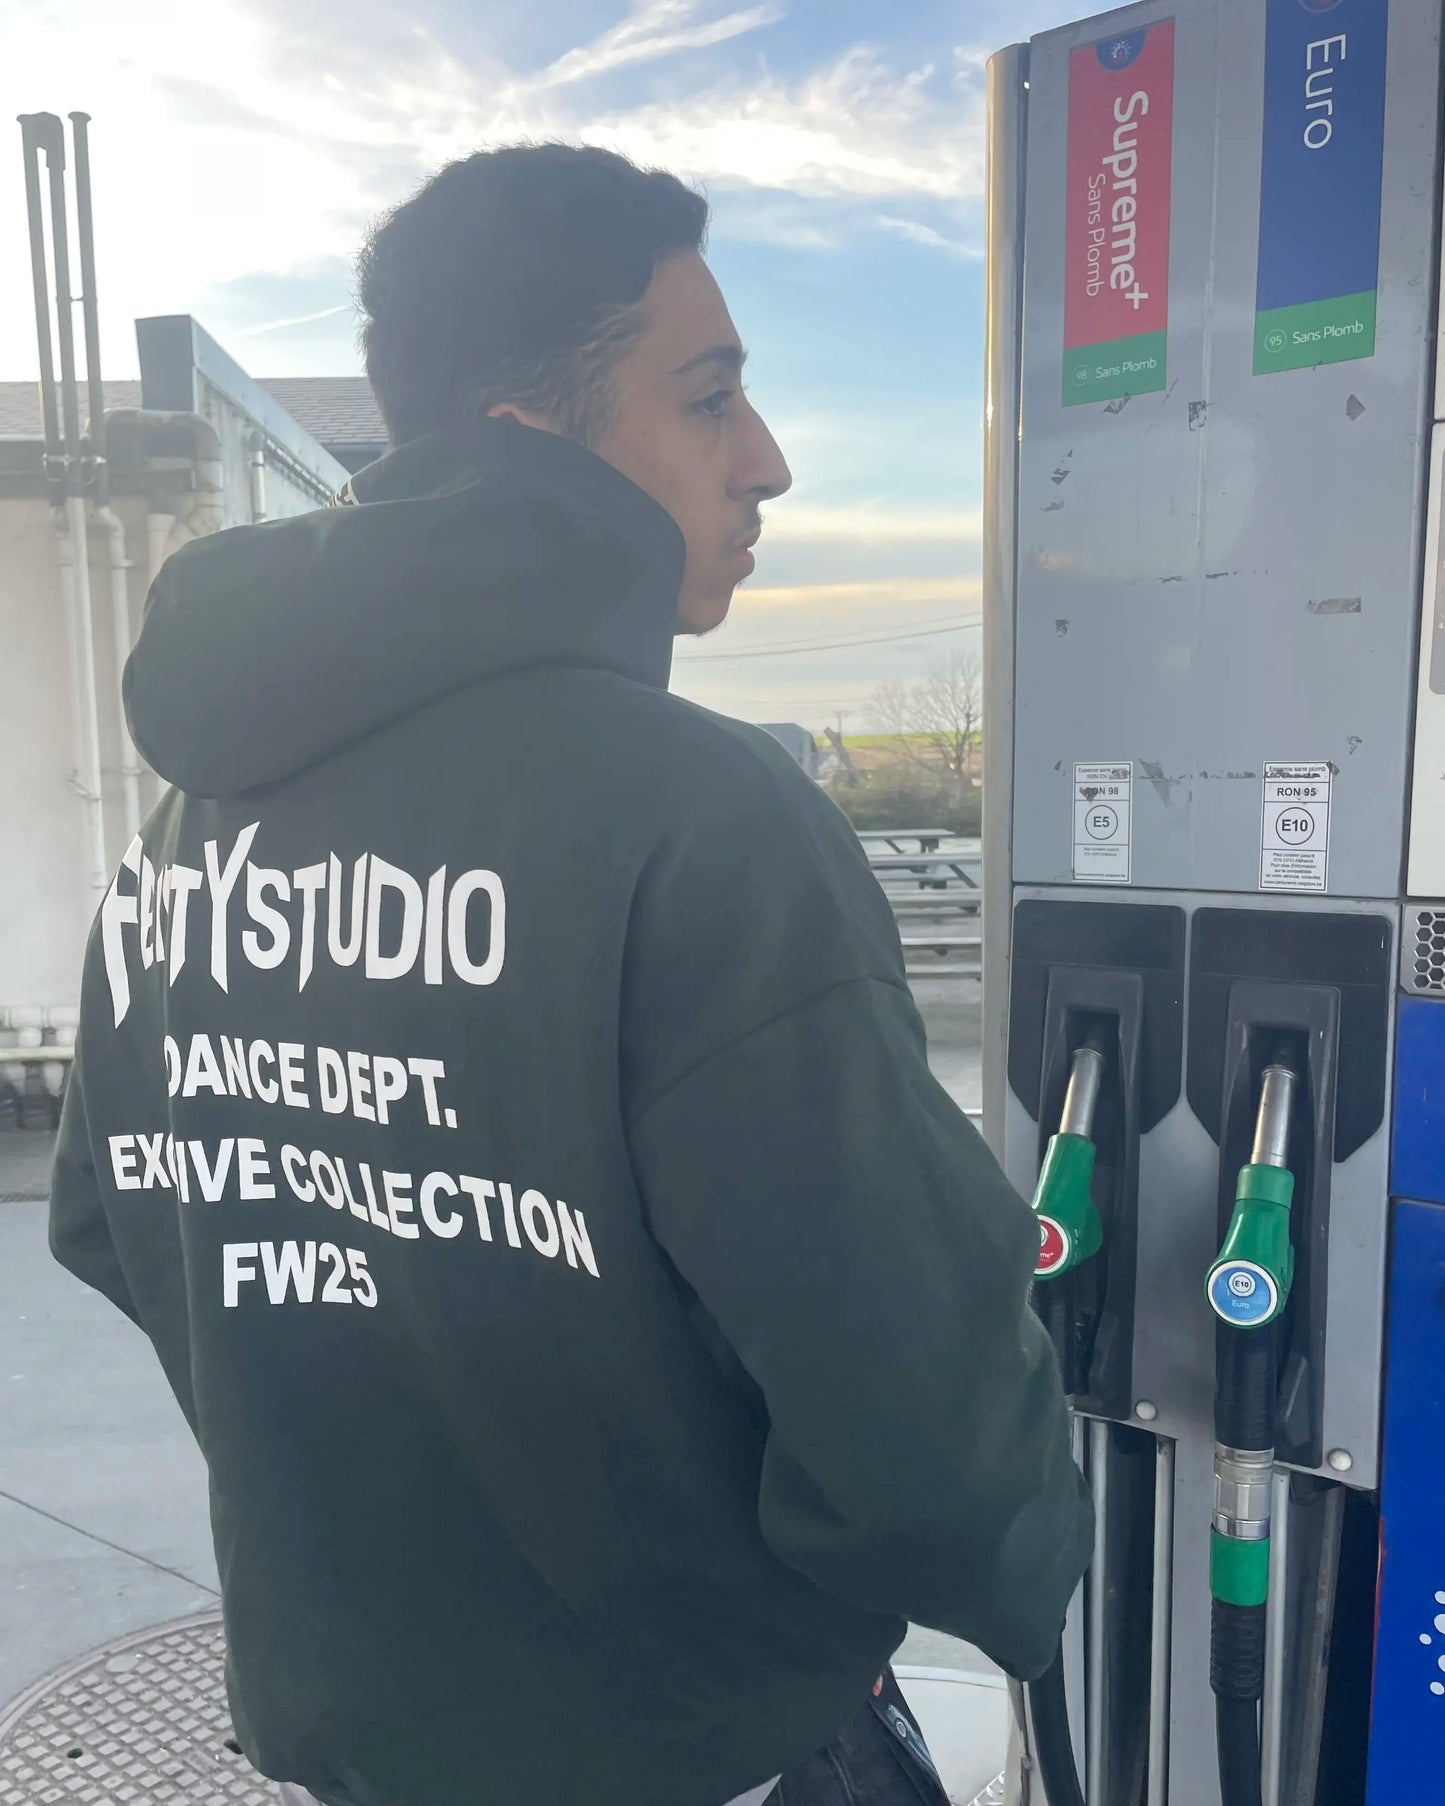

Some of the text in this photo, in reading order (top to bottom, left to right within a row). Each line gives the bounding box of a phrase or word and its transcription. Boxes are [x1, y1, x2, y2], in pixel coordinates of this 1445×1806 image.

[1302, 33, 1346, 149] Euro
[1102, 90, 1149, 310] Supreme+
[1086, 173, 1106, 297] Sans Plomb
[1269, 320, 1364, 346] 95 Sans Plomb
[1095, 366, 1121, 379] Sans
[1122, 356, 1157, 373] Plomb
[1108, 786, 1119, 796] 98
[1276, 786, 1318, 797] RON 95
[1092, 815, 1110, 828] E5
[1281, 819, 1309, 833] E10
[163, 1033, 458, 1129] DANCE DEPT.
[280, 1143, 600, 1279] COLLECTION
[222, 1240, 378, 1308] FW25
[1234, 1280, 1250, 1289] E10
[1231, 1299, 1251, 1310] Euro
